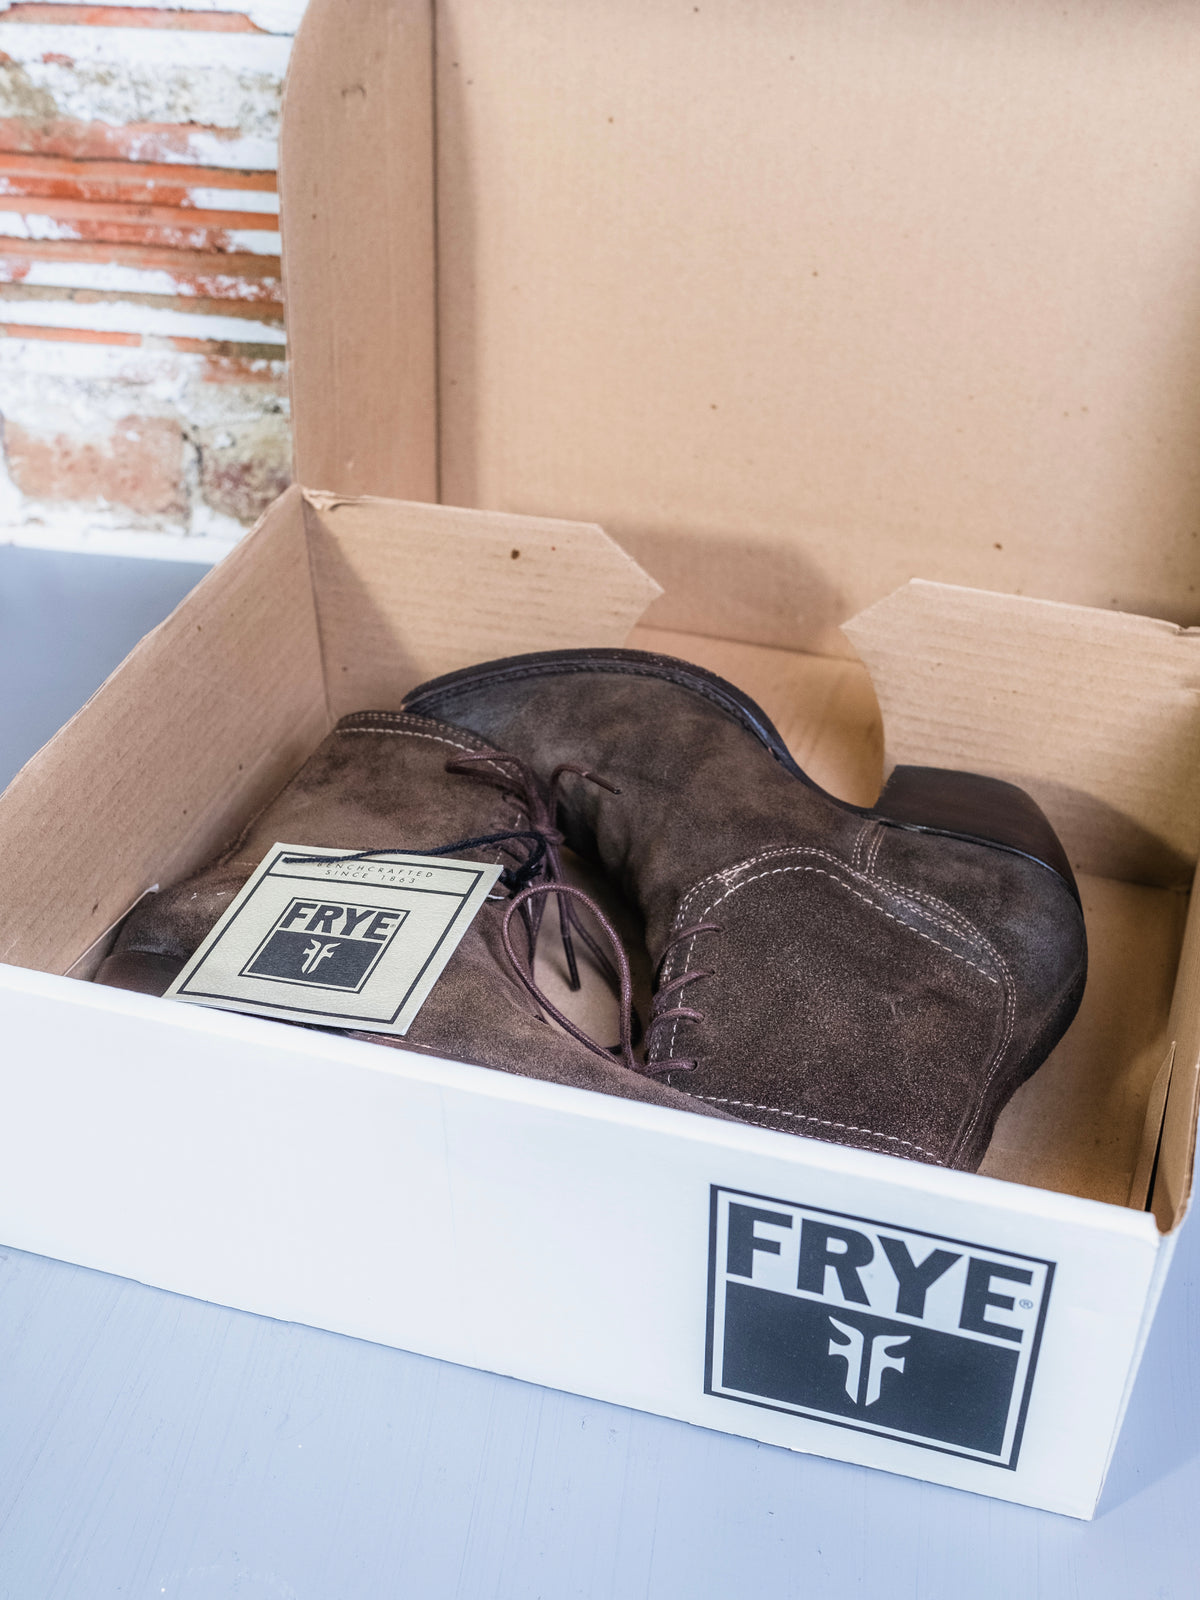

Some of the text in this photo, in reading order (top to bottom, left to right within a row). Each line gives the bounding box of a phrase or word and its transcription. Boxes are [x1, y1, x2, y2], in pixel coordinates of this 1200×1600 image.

[317, 862, 434, 879] BENCHCRAFTED
[325, 869, 417, 885] SINCE 1863
[279, 902, 401, 941] FRYE
[726, 1201, 1034, 1344] FRYE
